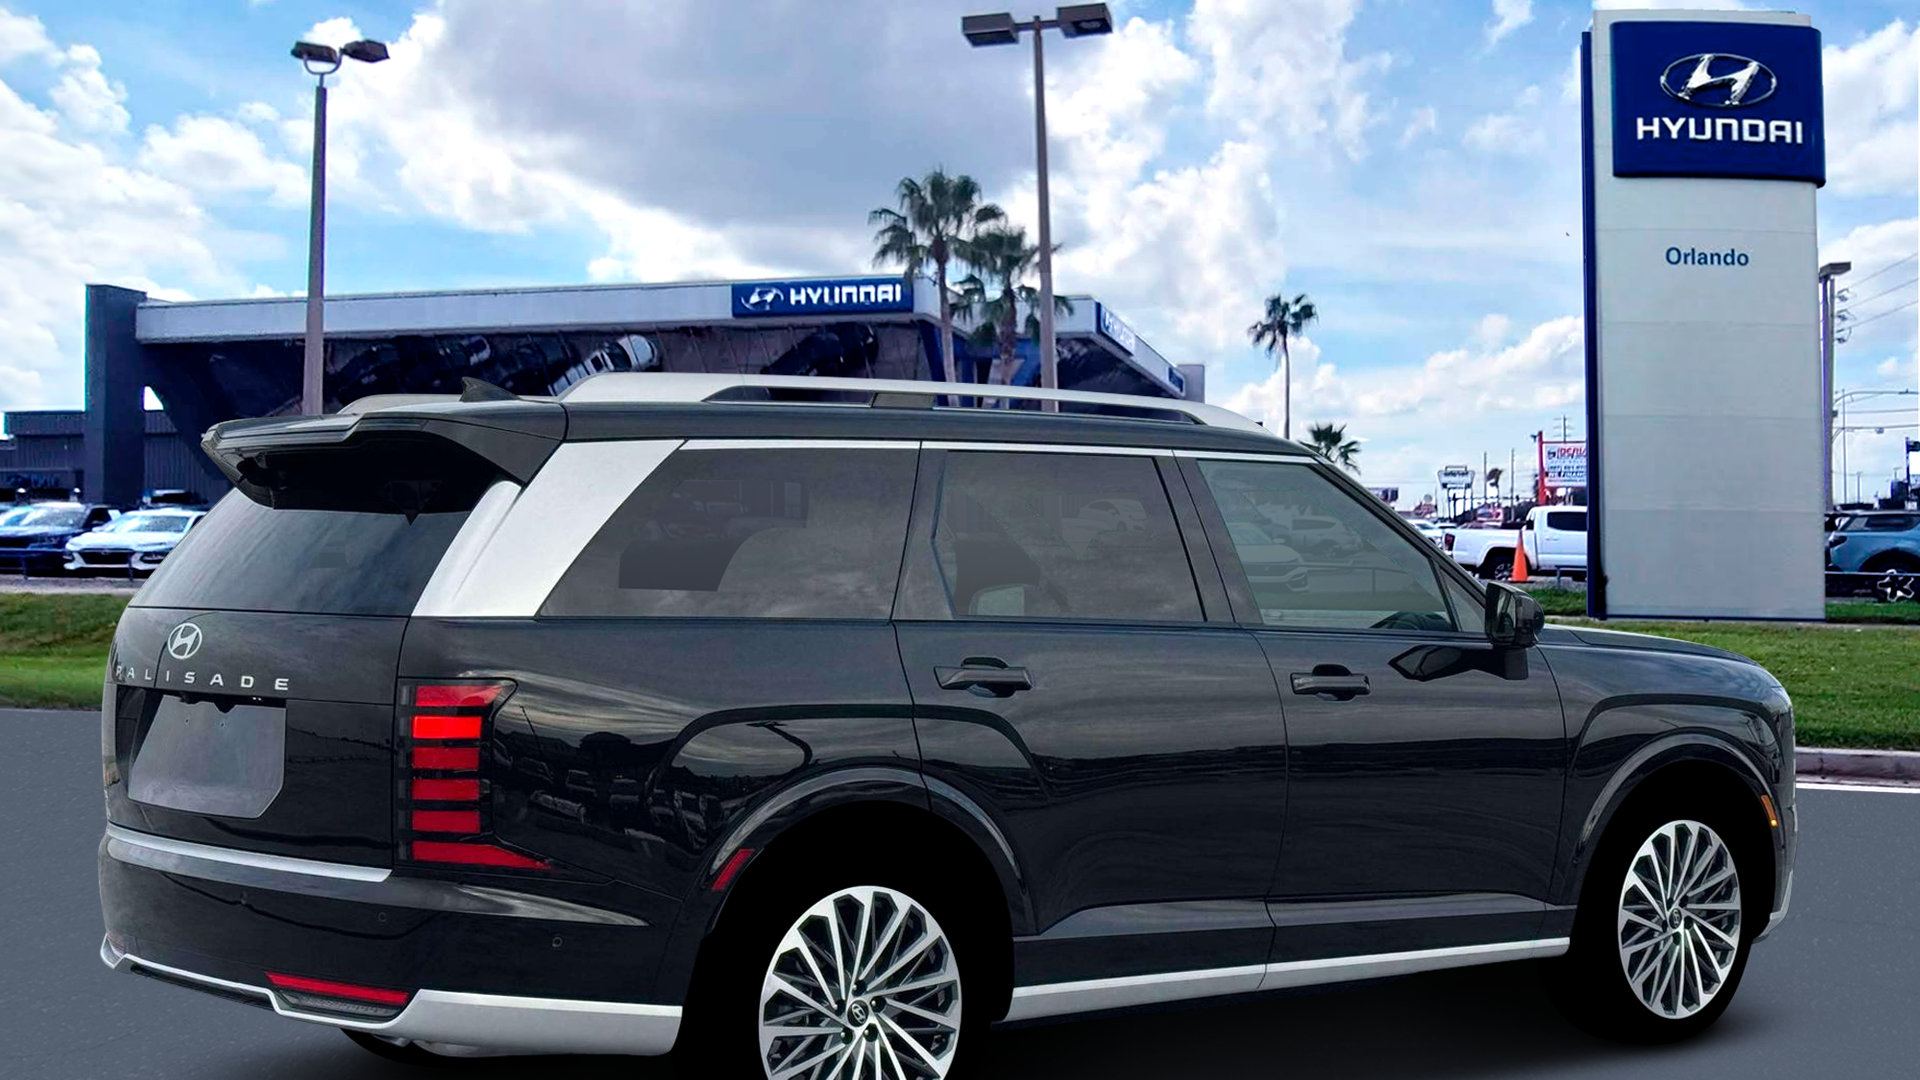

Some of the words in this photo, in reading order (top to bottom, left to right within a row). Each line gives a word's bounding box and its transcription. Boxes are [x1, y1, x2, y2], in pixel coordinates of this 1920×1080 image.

[1636, 116, 1804, 144] HYUNDAI
[1665, 247, 1750, 267] Orlando
[789, 283, 902, 306] HYUNDAI
[115, 665, 290, 691] PALISADE
